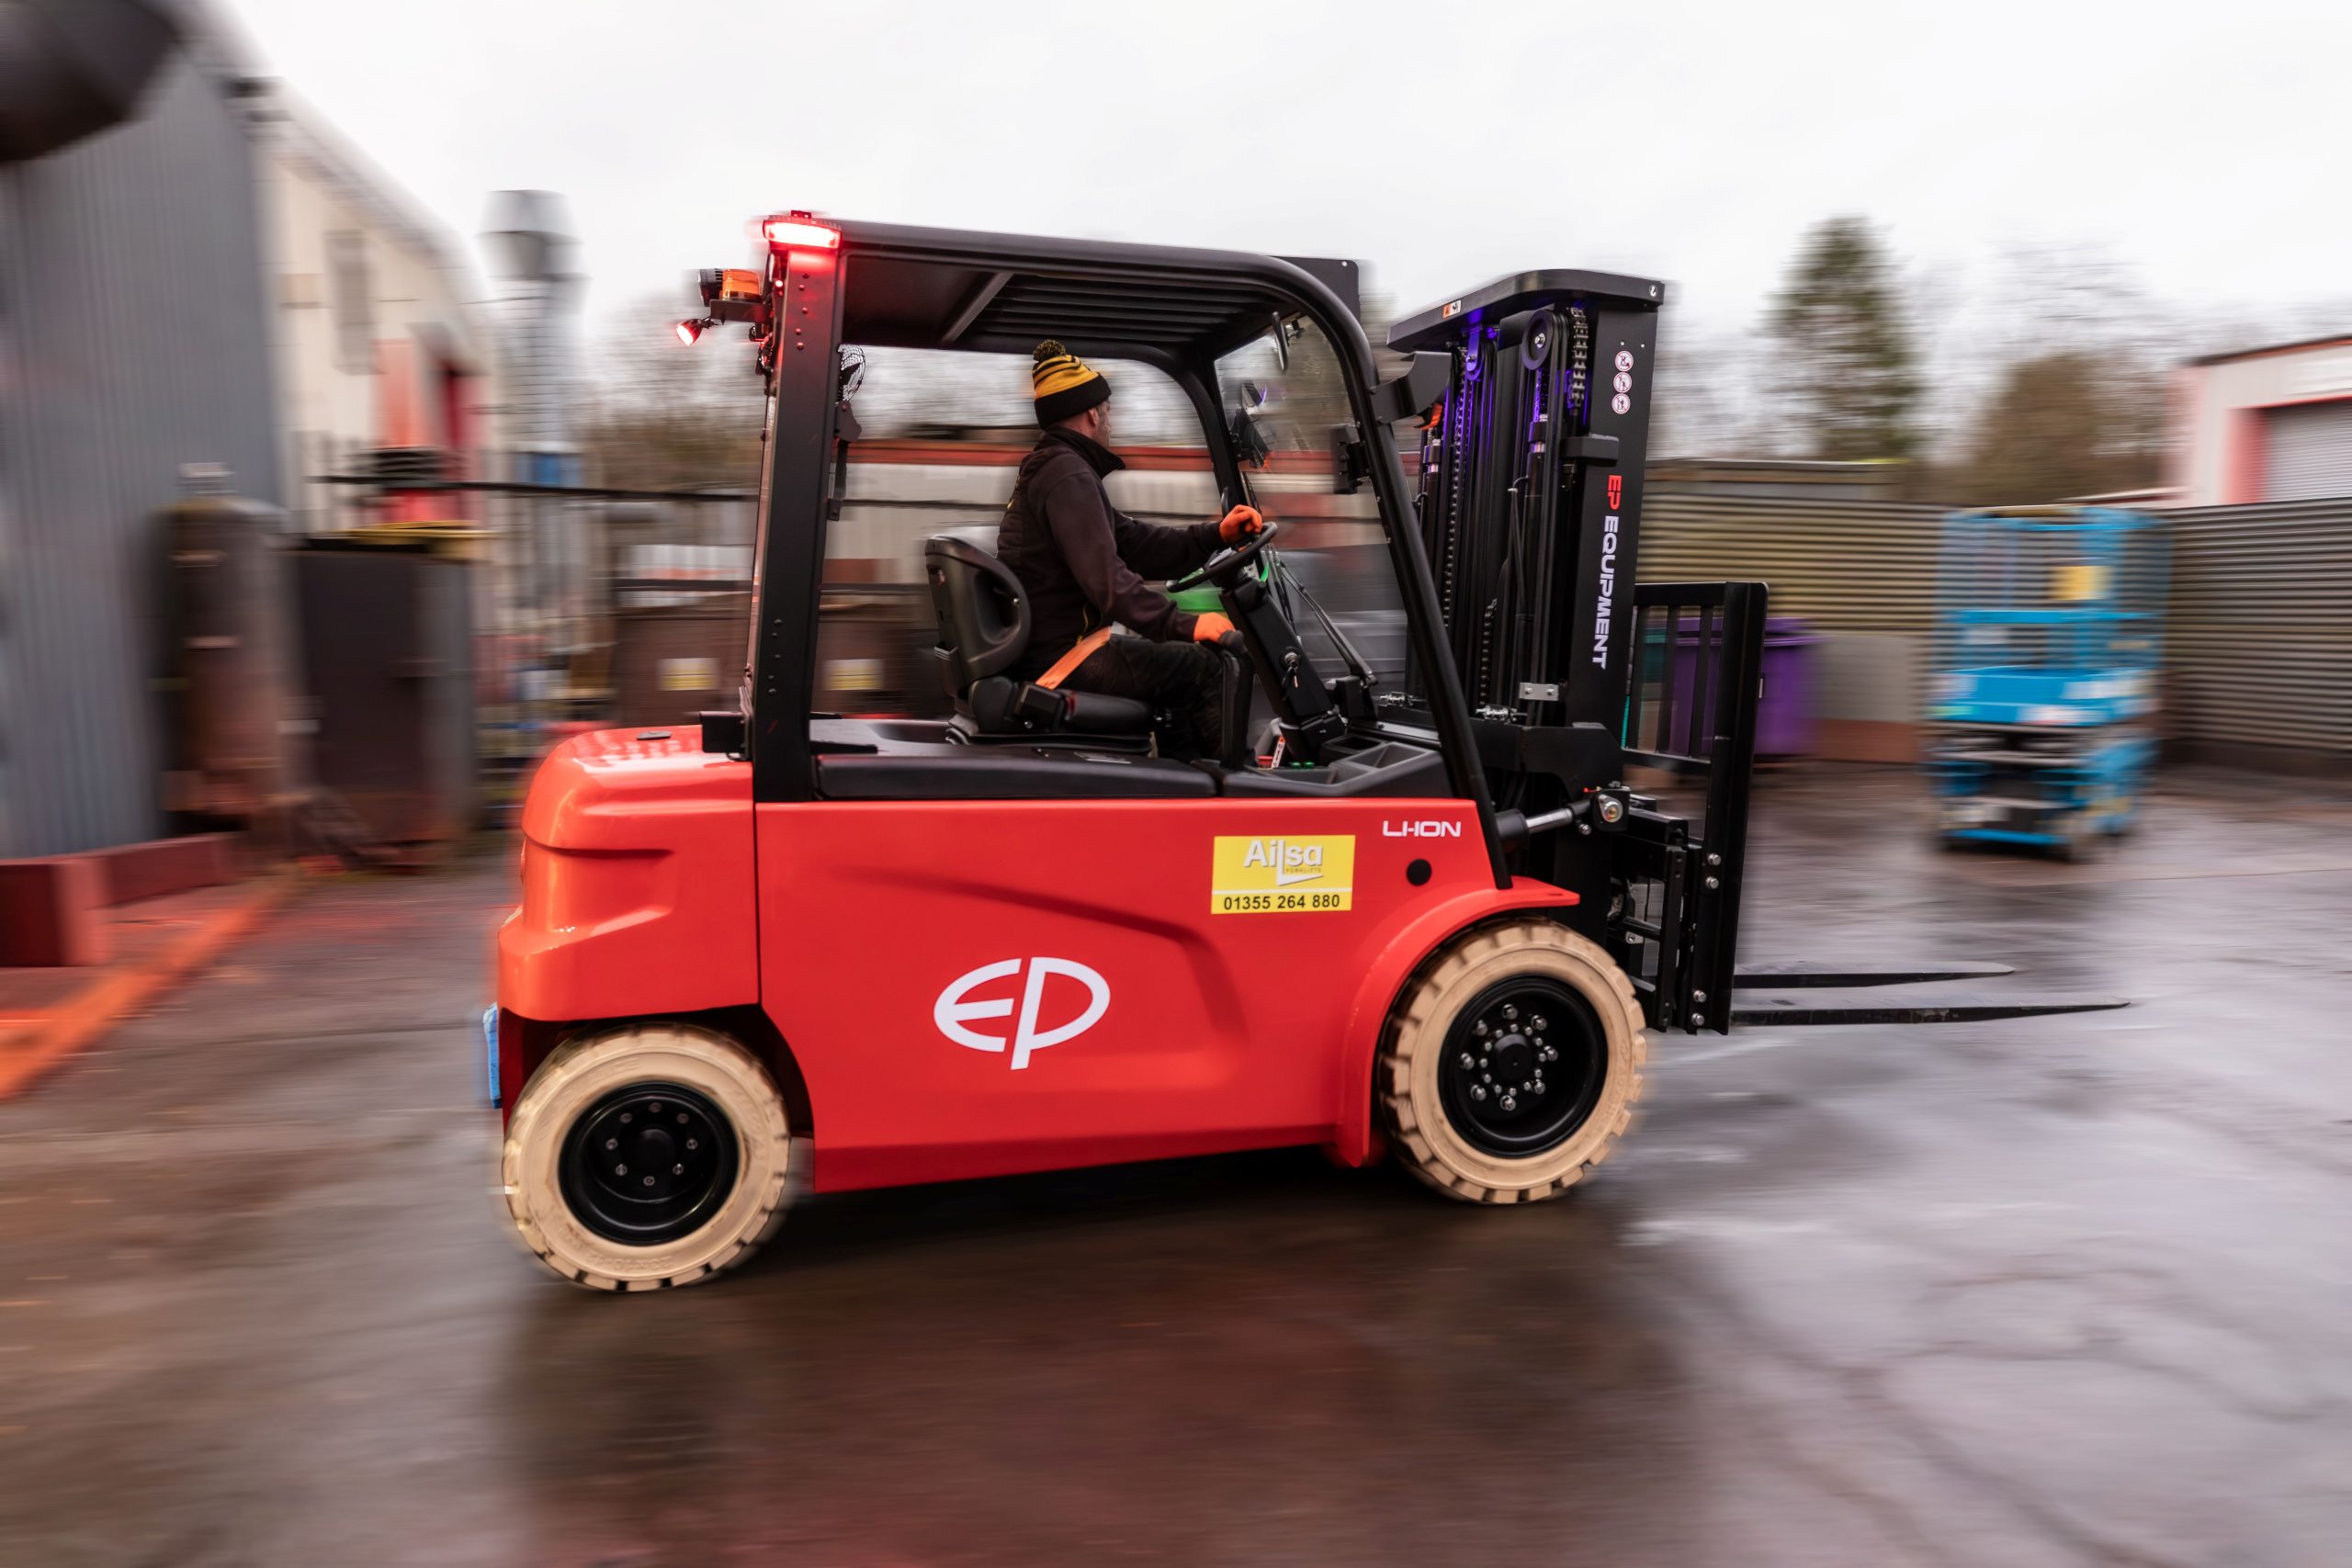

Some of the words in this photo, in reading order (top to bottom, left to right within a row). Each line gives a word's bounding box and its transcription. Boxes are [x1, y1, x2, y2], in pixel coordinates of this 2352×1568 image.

[1607, 475, 1623, 511] EP
[1592, 515, 1619, 670] EQUIPMENT
[1244, 839, 1323, 886] Ailsa
[1224, 897, 1271, 910] 01355
[1277, 895, 1305, 908] 264
[1312, 894, 1340, 908] 880
[933, 956, 1111, 1070] EP
